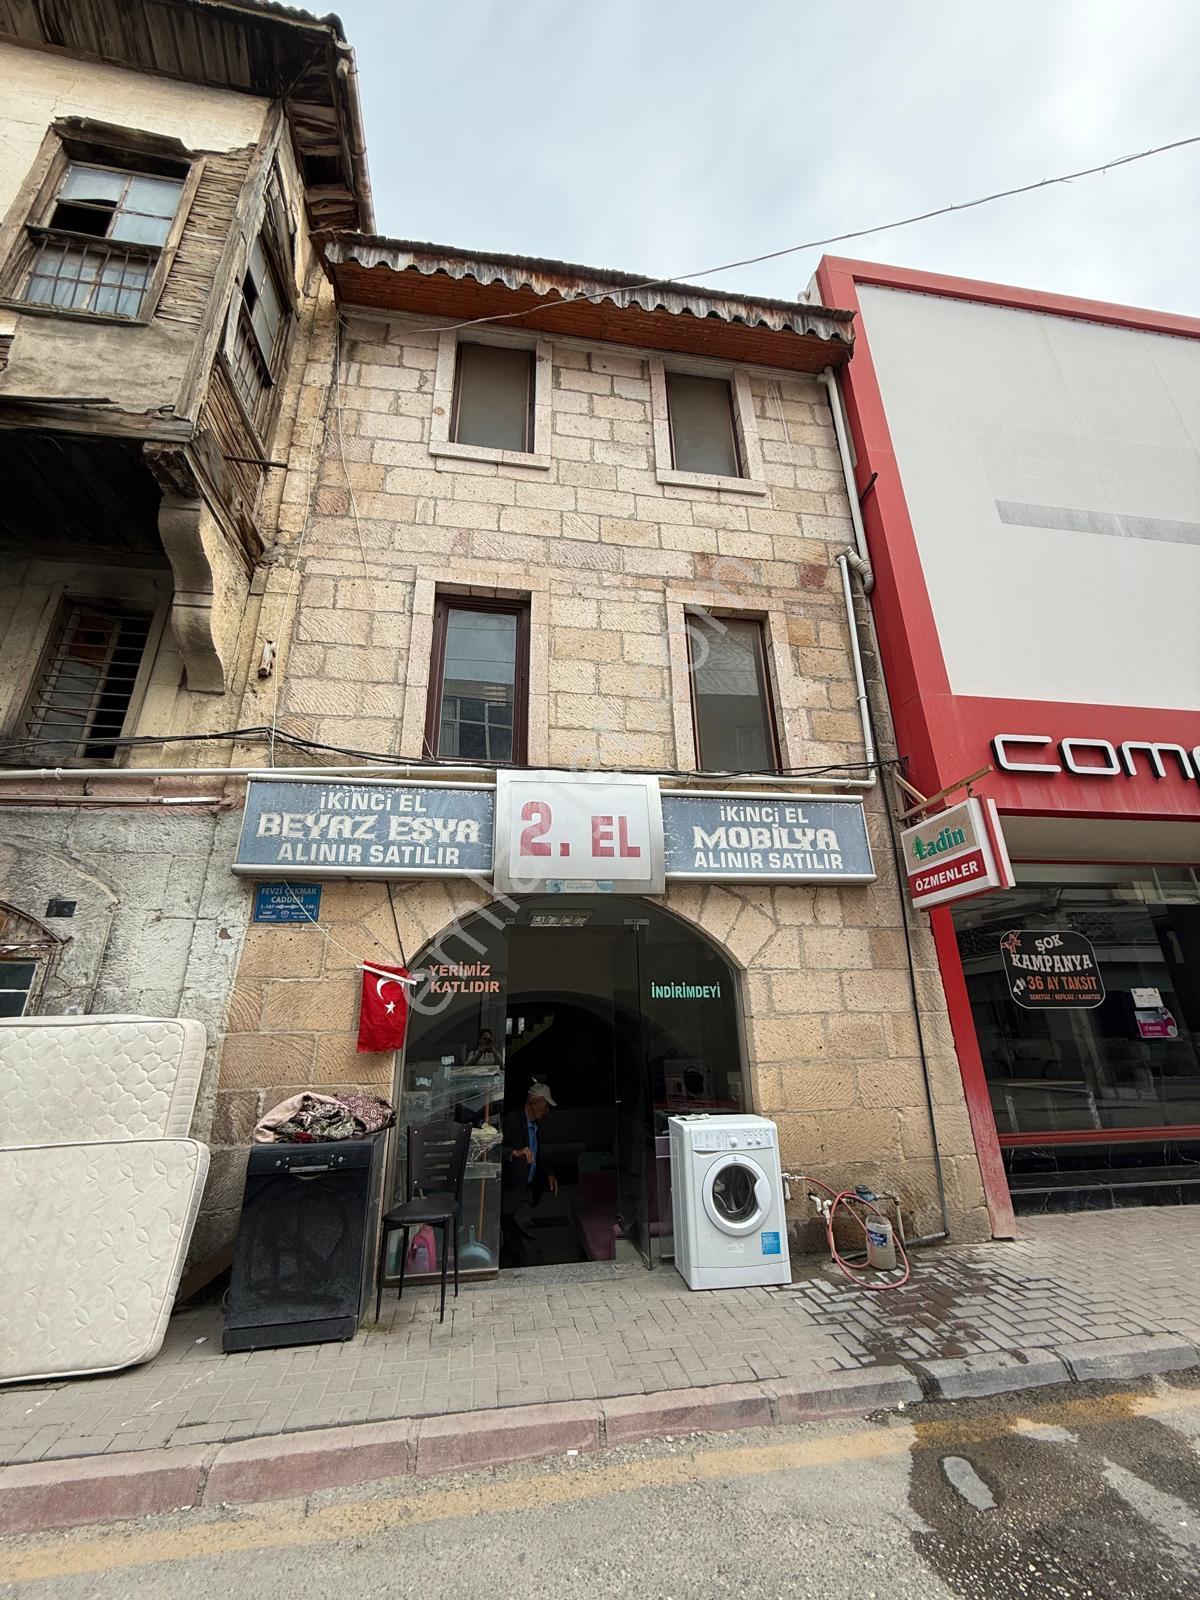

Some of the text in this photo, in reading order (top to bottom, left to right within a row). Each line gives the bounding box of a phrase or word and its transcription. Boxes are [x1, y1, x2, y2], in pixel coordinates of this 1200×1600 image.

[991, 733, 1200, 780] com
[399, 794, 427, 812] EL
[785, 807, 809, 824] EL
[256, 811, 482, 845] BEYAZ EŞYA
[519, 800, 641, 858] 2. EL
[692, 823, 841, 852] MOBİLYA
[912, 826, 967, 860] tadin
[277, 842, 460, 865] ALINIR SATILIR
[694, 851, 844, 870] ALINIR SATILIR
[915, 860, 979, 892] ÖZMENLER
[261, 886, 283, 895] FEVZİ
[1034, 934, 1064, 954] ŞOK
[429, 961, 491, 977] YERİMİZ
[1011, 954, 1093, 973] KAMPANYA
[430, 980, 500, 993] KATLIDIR
[651, 981, 721, 998] İNDİRİMDEYİ
[1026, 973, 1098, 990] 36 AY TAKSİT
